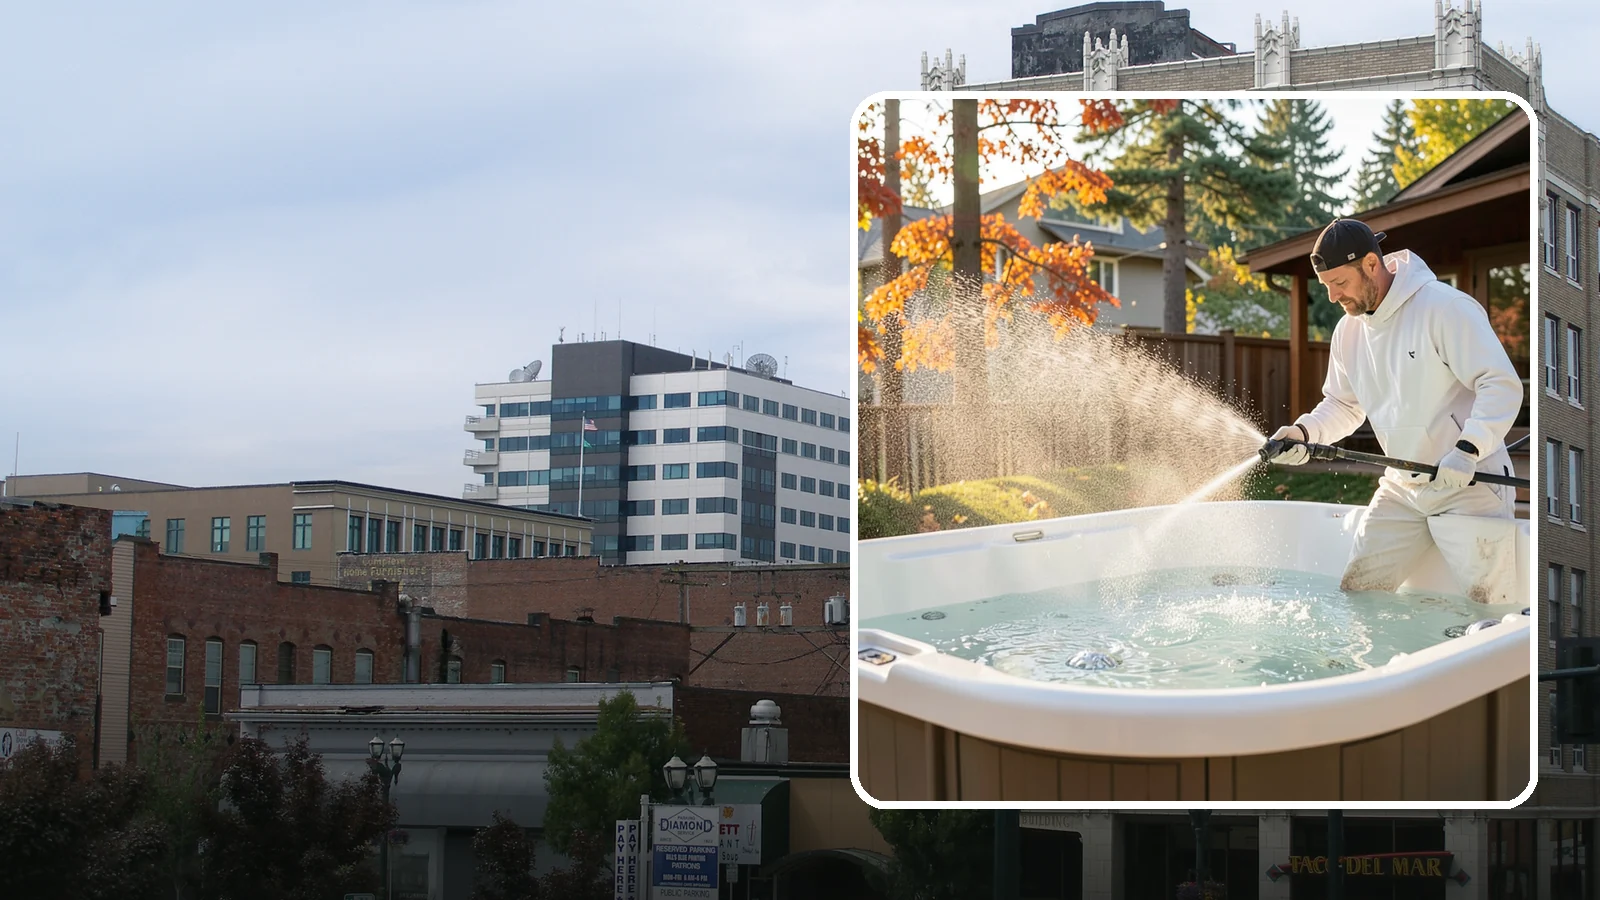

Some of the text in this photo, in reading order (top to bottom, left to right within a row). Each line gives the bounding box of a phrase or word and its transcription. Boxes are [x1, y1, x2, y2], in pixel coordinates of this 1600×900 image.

[343, 566, 427, 577] Home Furnishers
[660, 818, 713, 833] DIAMOND
[1022, 815, 1070, 828] BUILDING
[655, 845, 716, 854] RESERVED PARKING
[616, 825, 625, 893] PAY HERE
[627, 824, 637, 893] PAY HERE
[671, 862, 701, 870] PATRONS
[1289, 855, 1442, 877] TAC DEL MAR
[660, 888, 710, 898] PUBLIC PARKING
